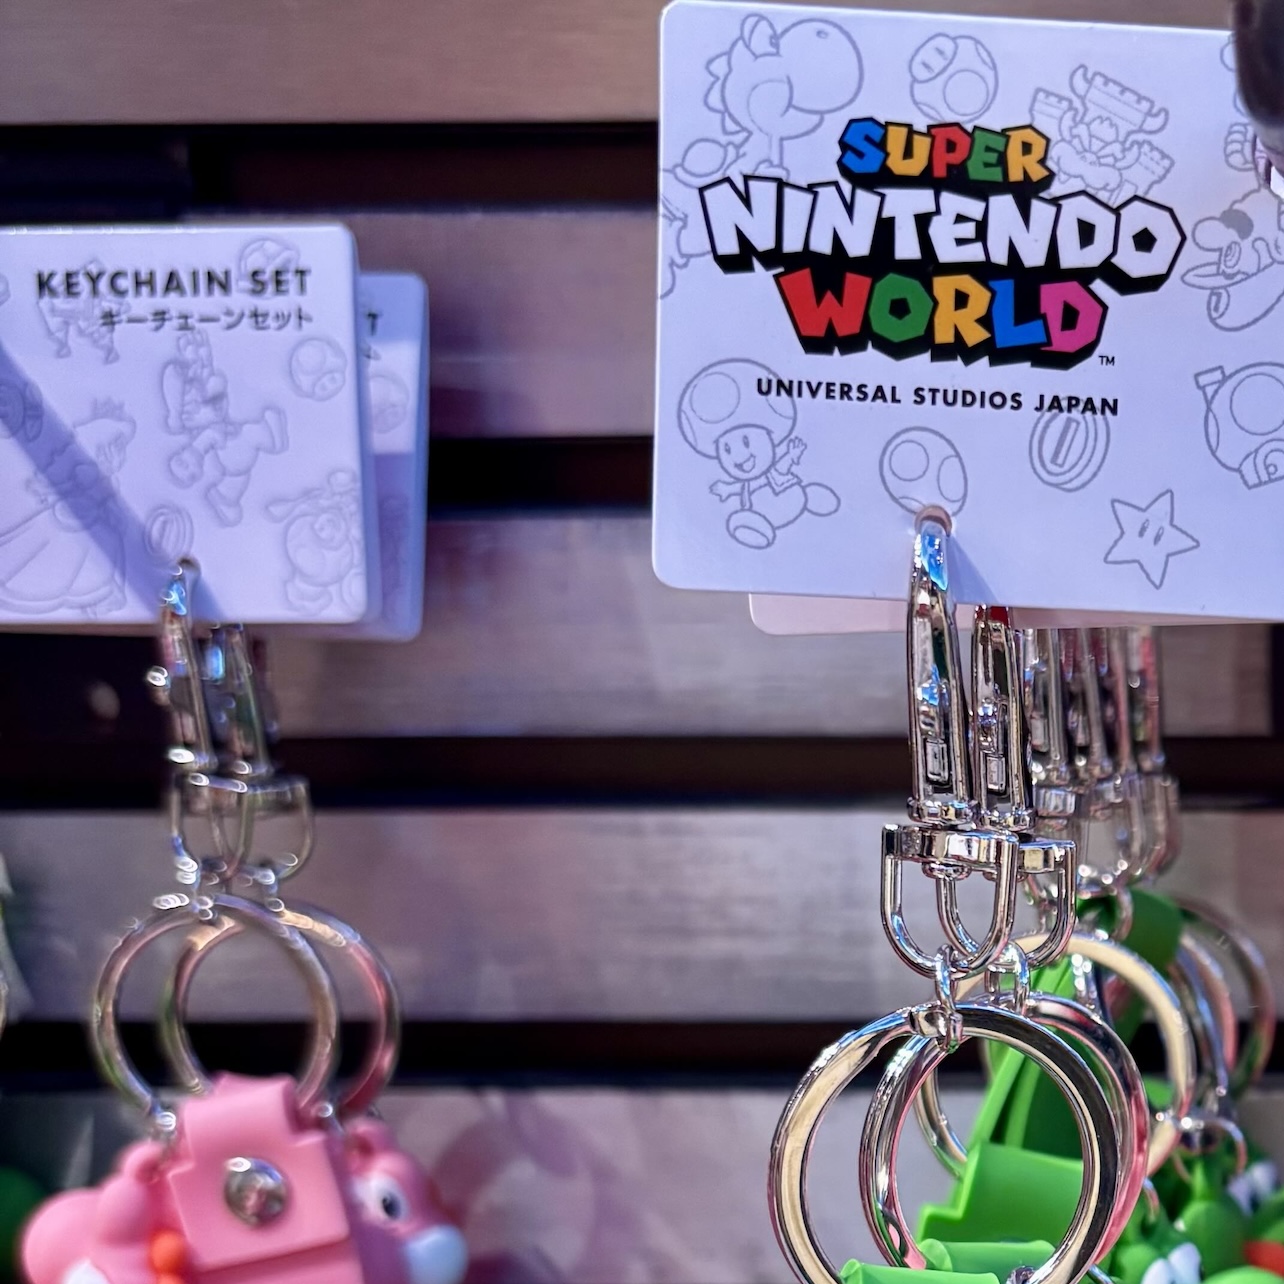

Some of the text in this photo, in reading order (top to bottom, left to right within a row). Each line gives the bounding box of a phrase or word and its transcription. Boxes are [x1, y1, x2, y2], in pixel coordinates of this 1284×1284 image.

[838, 117, 1052, 186] SUPER
[702, 177, 1184, 285] NINTENDO
[36, 268, 312, 298] KEYCHAIN SET
[100, 305, 313, 331] キーチェーンセット
[776, 268, 1107, 360] WORLD
[756, 377, 1119, 417] UNIVERSAL STUDIOS JAPAN
